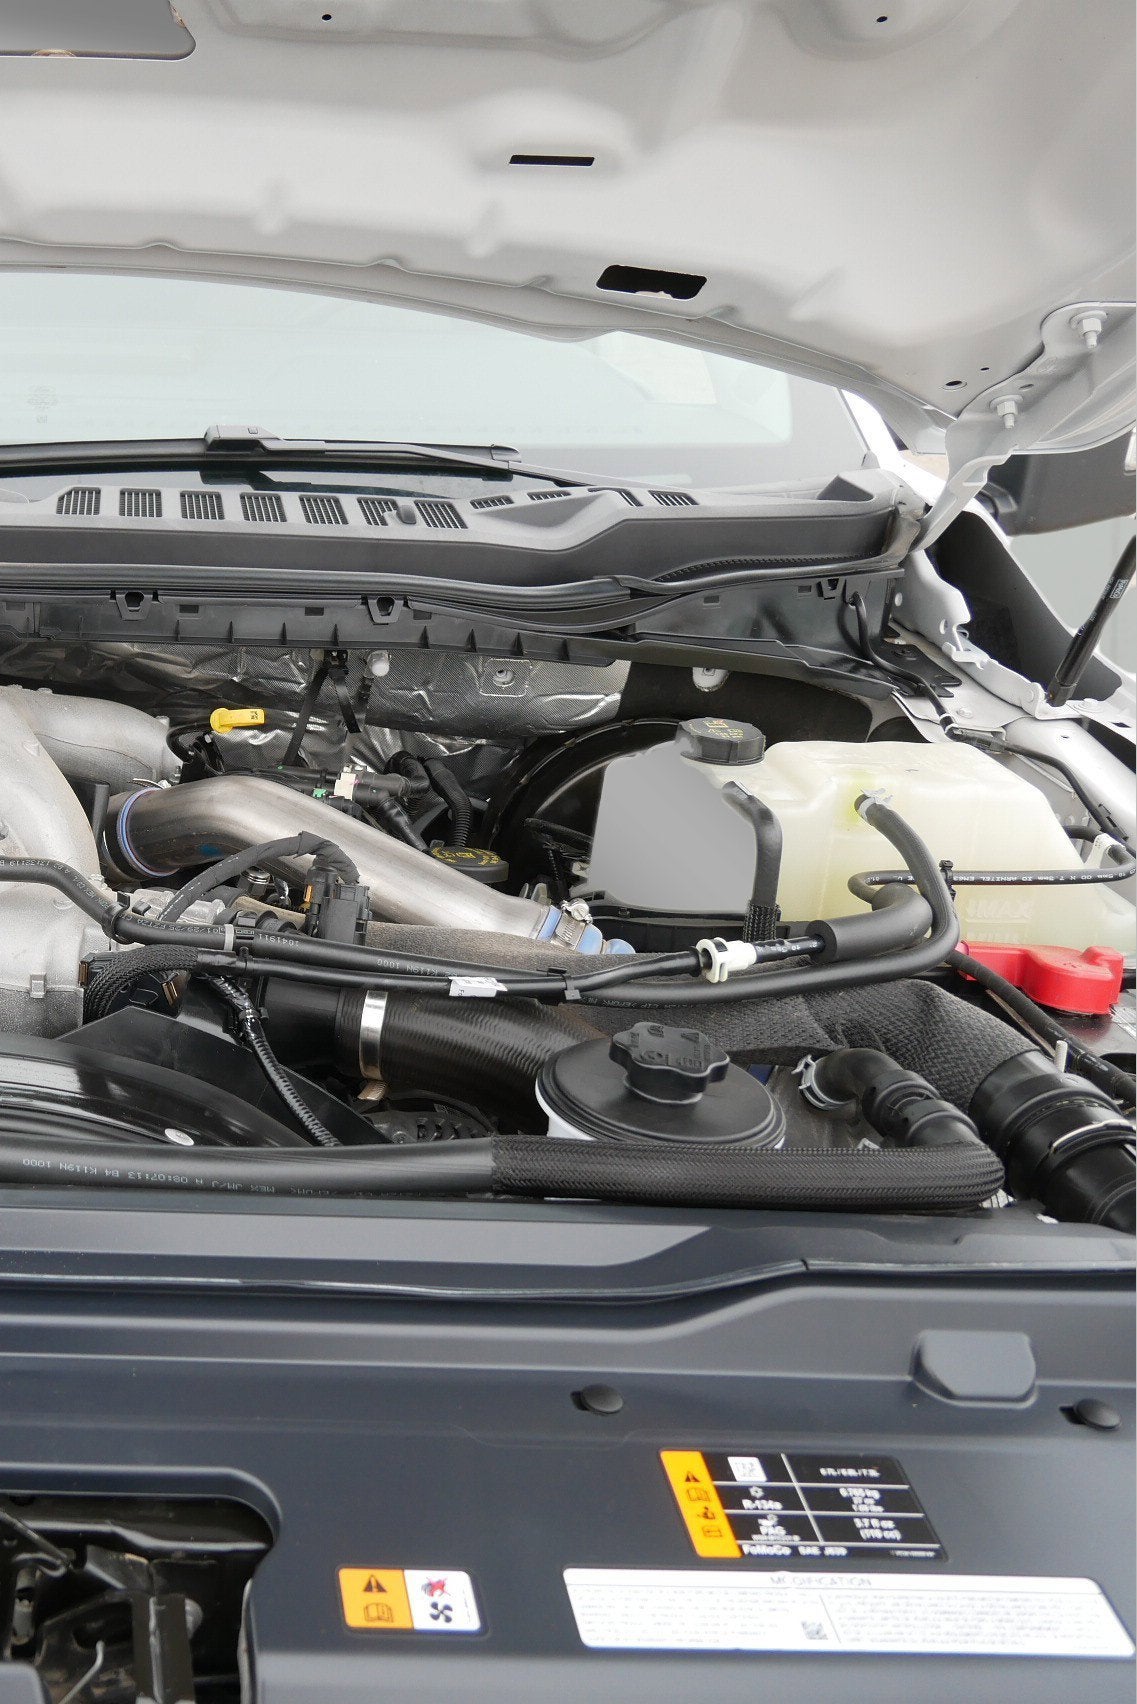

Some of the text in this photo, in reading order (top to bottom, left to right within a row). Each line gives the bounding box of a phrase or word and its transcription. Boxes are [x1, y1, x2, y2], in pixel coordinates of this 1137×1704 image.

[58, 1161, 97, 1174] K119N
[103, 1168, 119, 1177] B4
[127, 1170, 188, 1184] 08:07:13
[742, 1544, 792, 1556] FoMoCo
